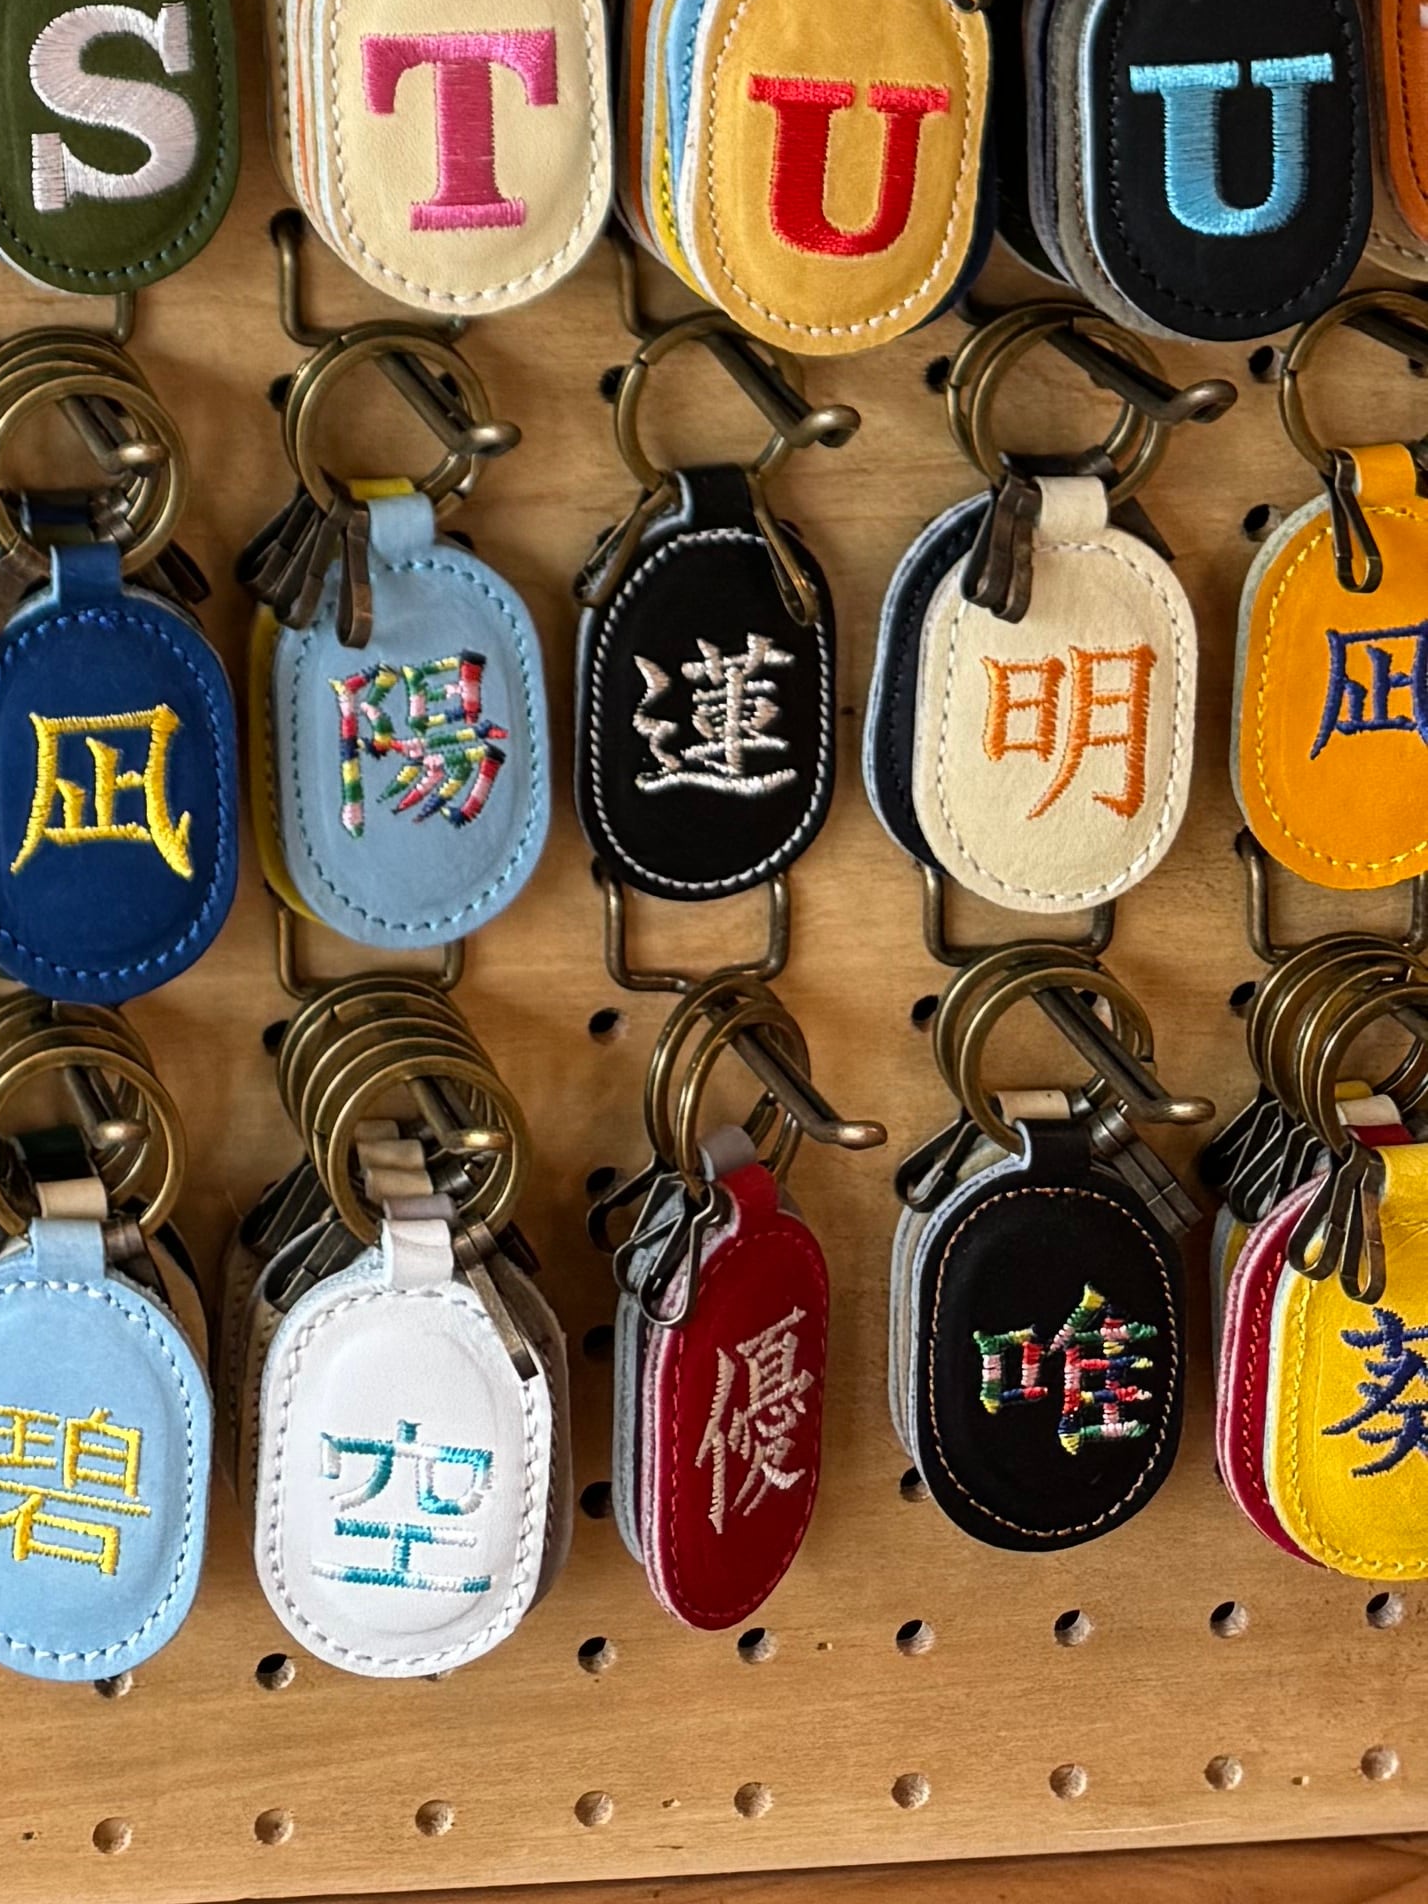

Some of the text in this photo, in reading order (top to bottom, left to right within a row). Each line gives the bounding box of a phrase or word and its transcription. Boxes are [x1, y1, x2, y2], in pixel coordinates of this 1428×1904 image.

[28, 1, 201, 215] S
[361, 26, 560, 232] T
[746, 72, 953, 258] U
[1128, 53, 1334, 238] U
[8, 703, 194, 882] 凪
[328, 648, 509, 840] 陽
[632, 632, 797, 794] 蓮
[981, 642, 1160, 823] 明
[694, 1305, 815, 1535] 優
[971, 1283, 1157, 1457] 唯
[310, 1420, 498, 1595] 空
